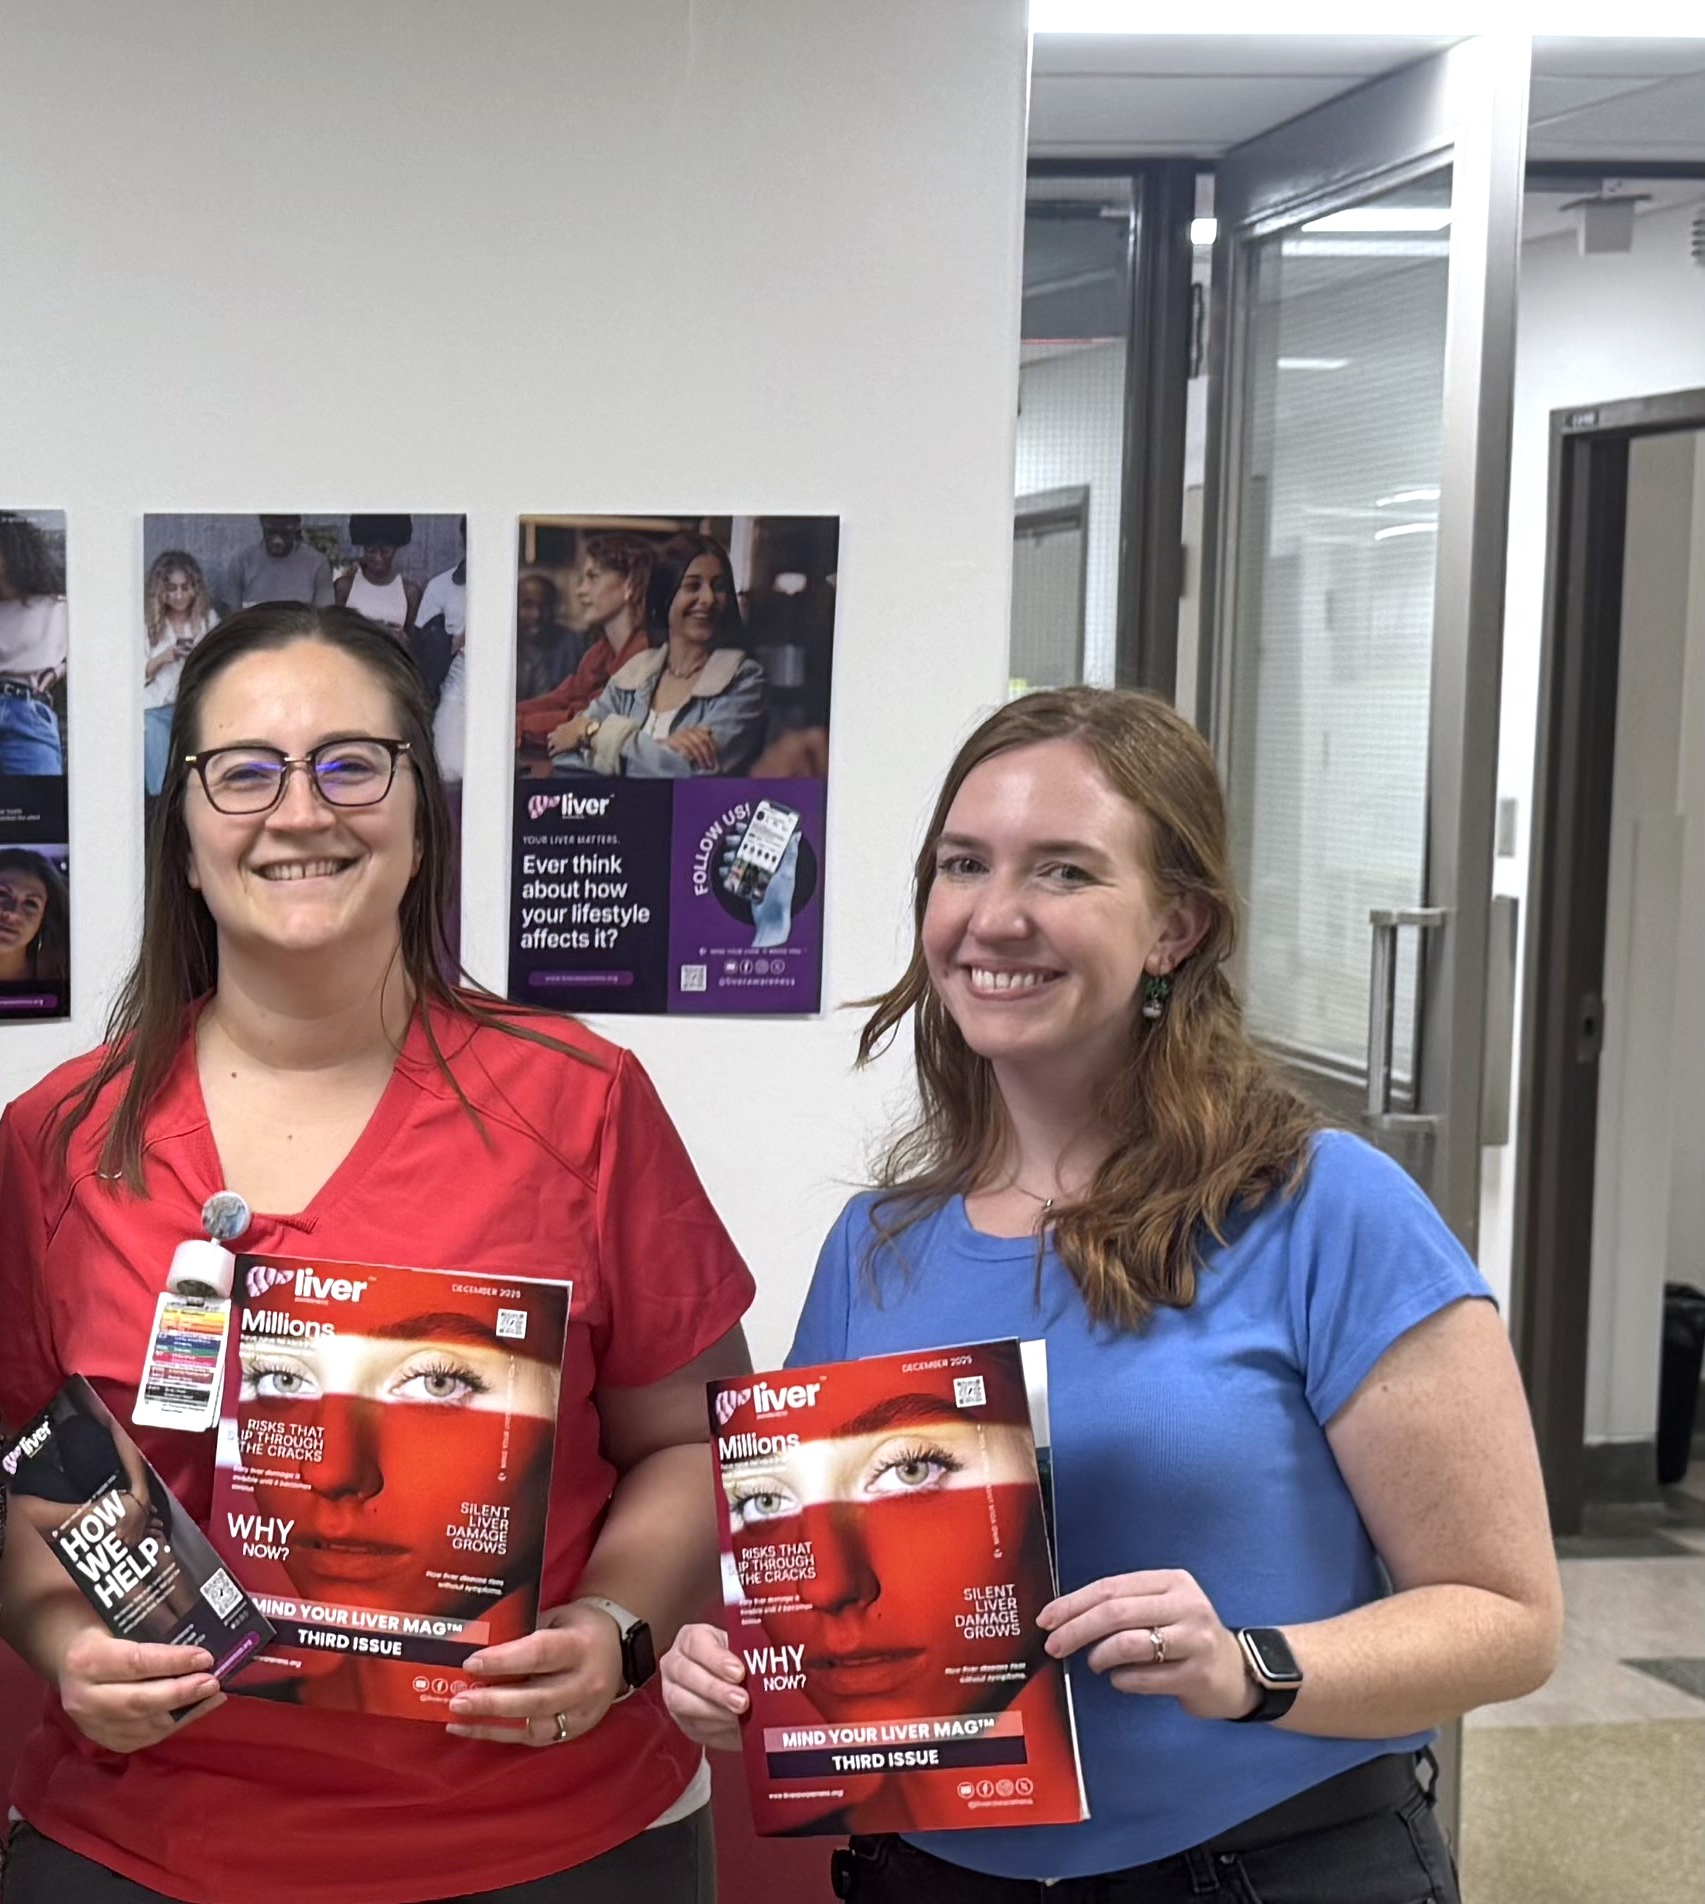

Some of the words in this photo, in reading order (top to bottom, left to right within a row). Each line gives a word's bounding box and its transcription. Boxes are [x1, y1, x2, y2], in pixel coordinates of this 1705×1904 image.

[561, 792, 610, 816] liver
[693, 821, 723, 896] FOLLOW
[722, 802, 751, 826] US!
[523, 854, 569, 875] Ever
[572, 854, 623, 875] think
[522, 879, 580, 899] about
[584, 879, 628, 899] how
[521, 907, 568, 929] your
[571, 902, 650, 928] lifestyle
[520, 927, 590, 949] affects
[594, 927, 619, 949] it?
[295, 1267, 368, 1302] liver
[241, 1308, 335, 1338] Millions
[753, 1381, 821, 1413] liver
[21, 1420, 52, 1455] liver
[247, 1419, 285, 1433] RISKS
[289, 1424, 325, 1438] THAT
[239, 1441, 263, 1455] THE
[268, 1445, 322, 1462] CRACKS
[257, 1432, 324, 1450] THROUGH
[718, 1432, 800, 1460] Millions
[460, 1502, 510, 1518] SILENT
[60, 1489, 126, 1562] HOW
[227, 1512, 294, 1544] WHY
[469, 1515, 509, 1531] LIVER
[446, 1525, 507, 1543] DAMAGE
[76, 1531, 129, 1582] WE
[242, 1542, 290, 1561] NOW?
[452, 1538, 507, 1555] GROWS
[742, 1545, 776, 1560] RISKS
[779, 1541, 813, 1556] THAT
[94, 1537, 171, 1609] HELP.
[752, 1554, 814, 1571] THROUGH
[740, 1572, 762, 1585] THE
[764, 1567, 816, 1583] CRACKS
[962, 1584, 1015, 1601] SILENT
[251, 1597, 296, 1616] MIND
[300, 1604, 348, 1625] YOUR
[352, 1611, 399, 1630] LIVER
[975, 1597, 1017, 1612] LIVER
[955, 1610, 1018, 1627] DAMAGE
[964, 1623, 1020, 1639] GROWS
[297, 1629, 350, 1648] THIRD
[353, 1637, 403, 1656] ISSUE
[743, 1644, 805, 1675] WHY
[764, 1674, 806, 1691] NOW?
[783, 1731, 826, 1748] MIND
[829, 1728, 877, 1745] YOUR
[882, 1724, 929, 1740] LIVER
[832, 1754, 885, 1771] THIRD
[889, 1750, 939, 1767] ISSUE
